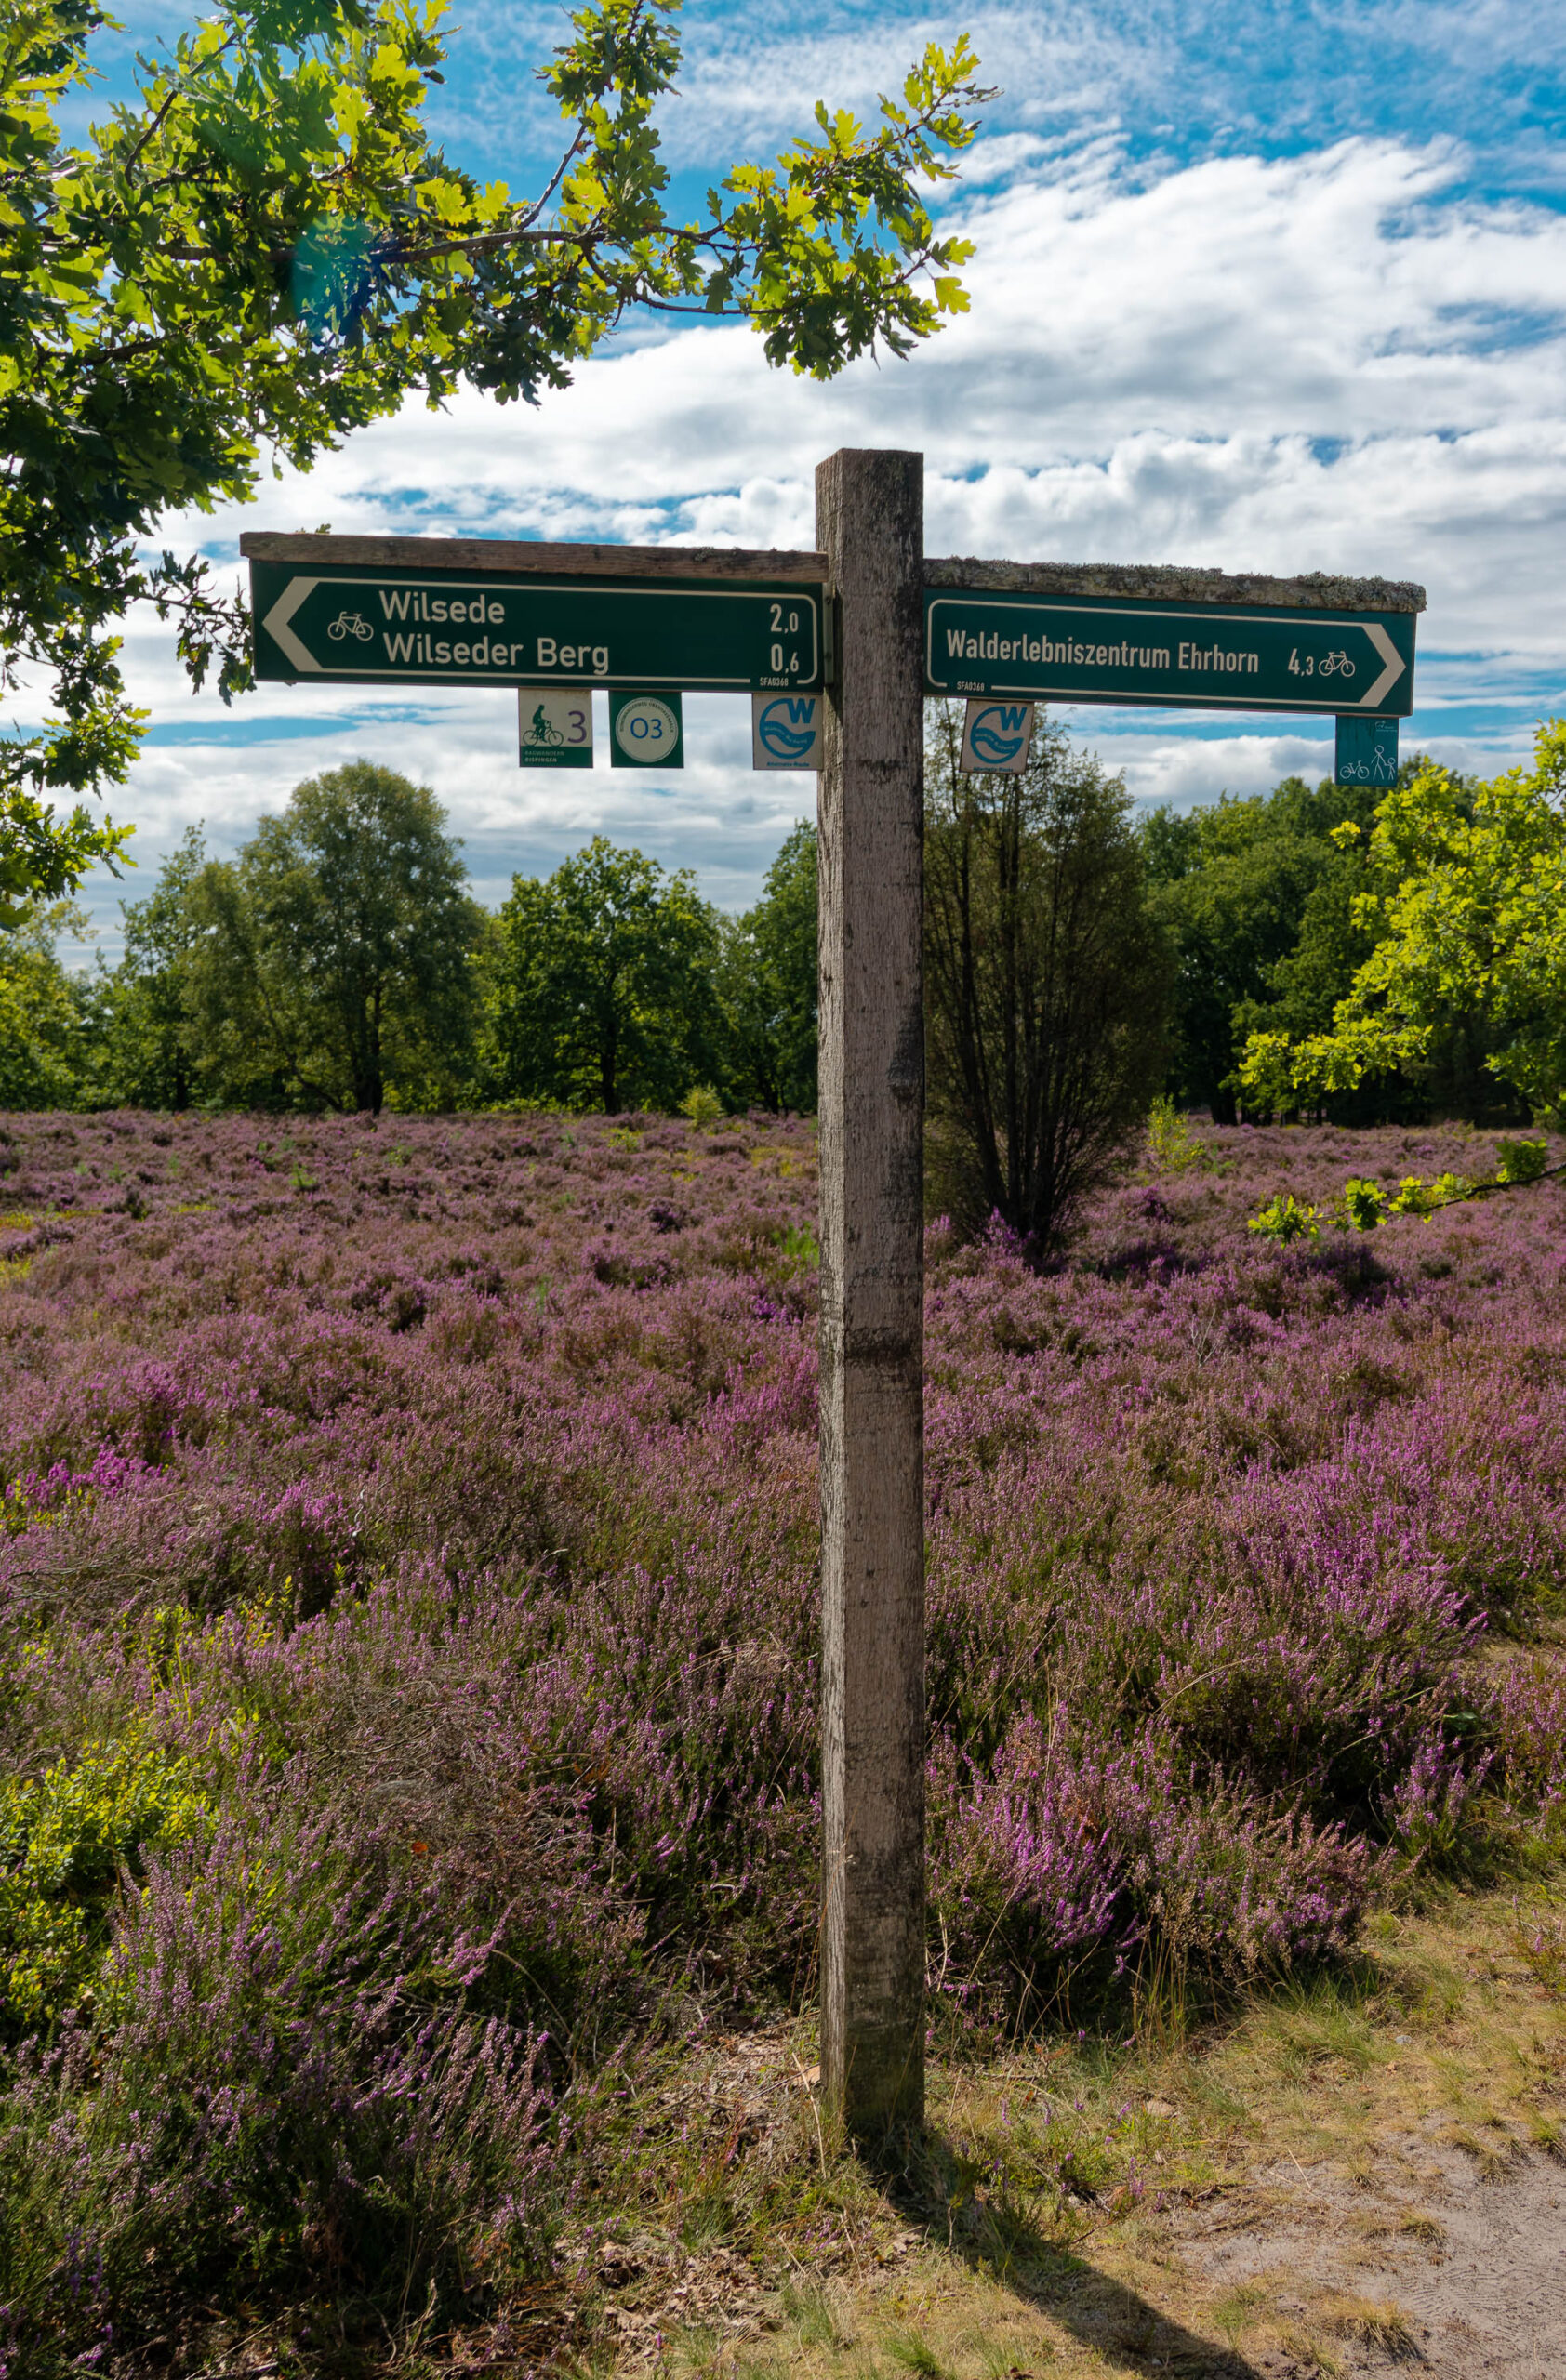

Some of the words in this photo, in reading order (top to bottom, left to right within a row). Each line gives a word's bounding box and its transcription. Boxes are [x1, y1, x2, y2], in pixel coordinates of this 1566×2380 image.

[379, 590, 505, 624] Wilsede
[770, 603, 799, 634] 2,0
[383, 632, 524, 666] Wilseder
[537, 637, 610, 676] Berg
[771, 643, 799, 674] 0,6
[947, 628, 1170, 669] Walderlebniszentrum
[1178, 641, 1259, 673] Ehrhorn
[1287, 648, 1314, 677] 4,3
[567, 710, 587, 744] 3
